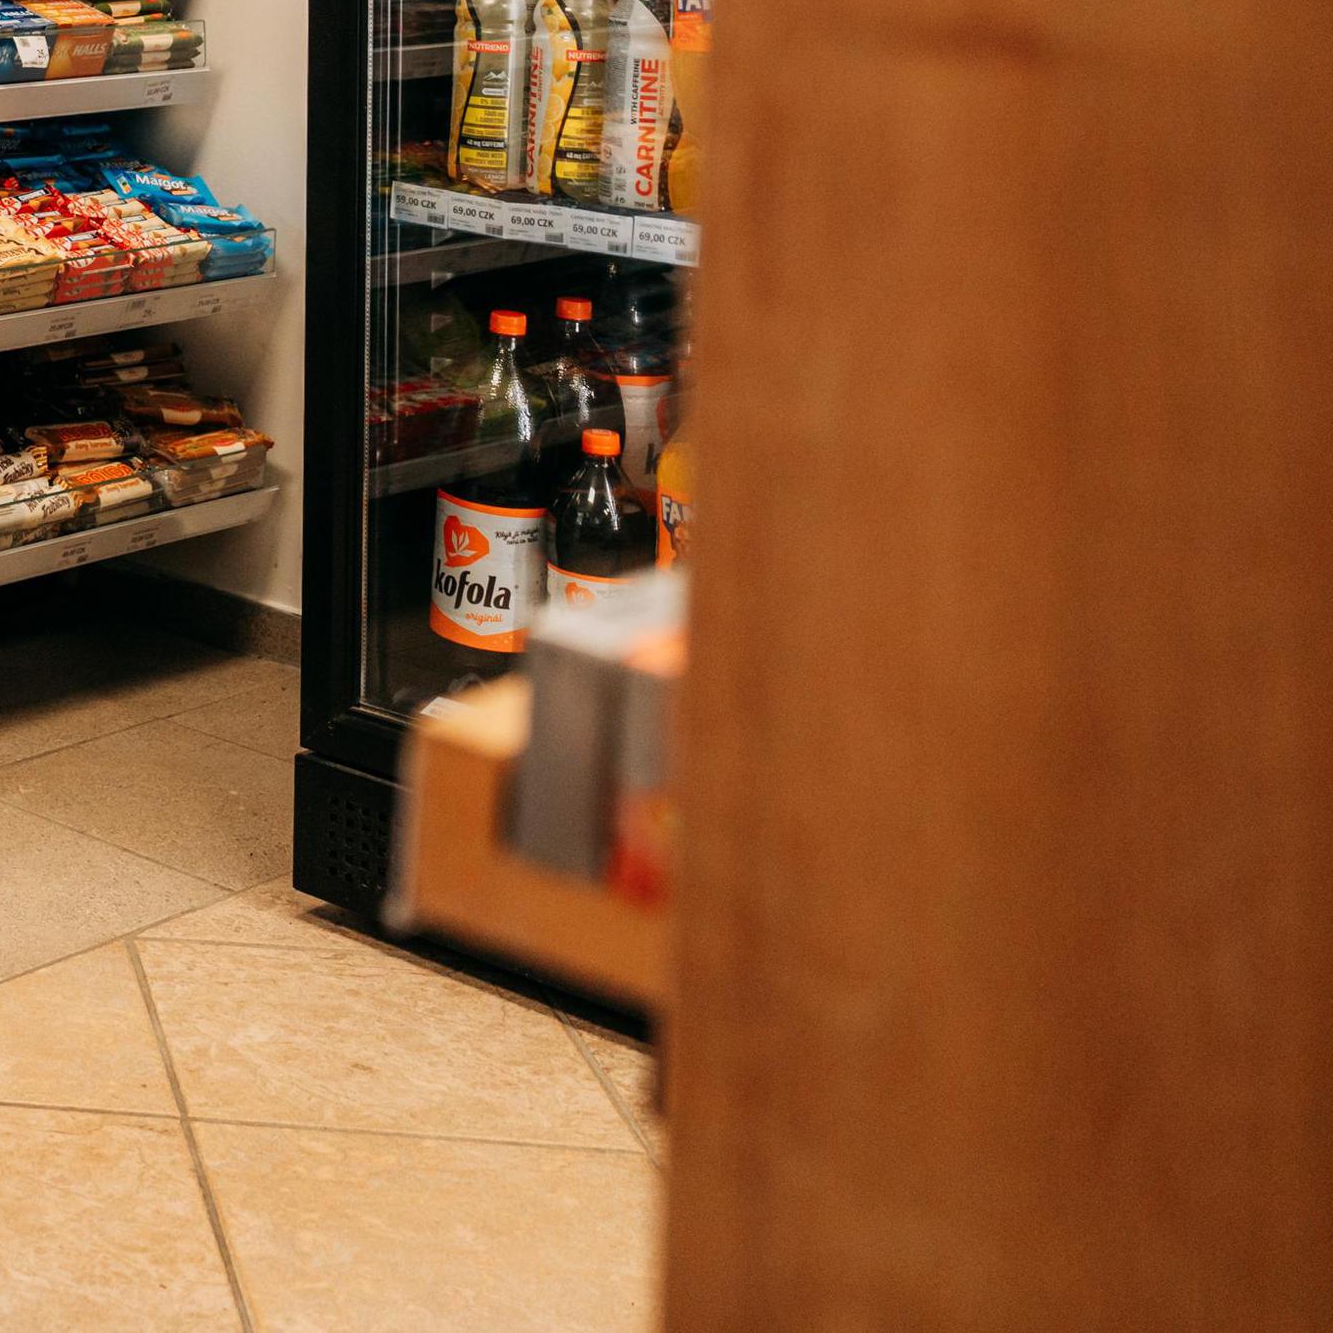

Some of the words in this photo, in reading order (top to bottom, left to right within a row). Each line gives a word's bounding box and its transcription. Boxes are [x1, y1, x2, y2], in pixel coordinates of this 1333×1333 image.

[469, 43, 510, 52] NUTREND
[635, 59, 660, 197] CARNITINE
[452, 206, 477, 217] 69,00
[479, 210, 494, 221] CZK
[435, 559, 511, 611] kofola
[465, 611, 502, 626] originál
